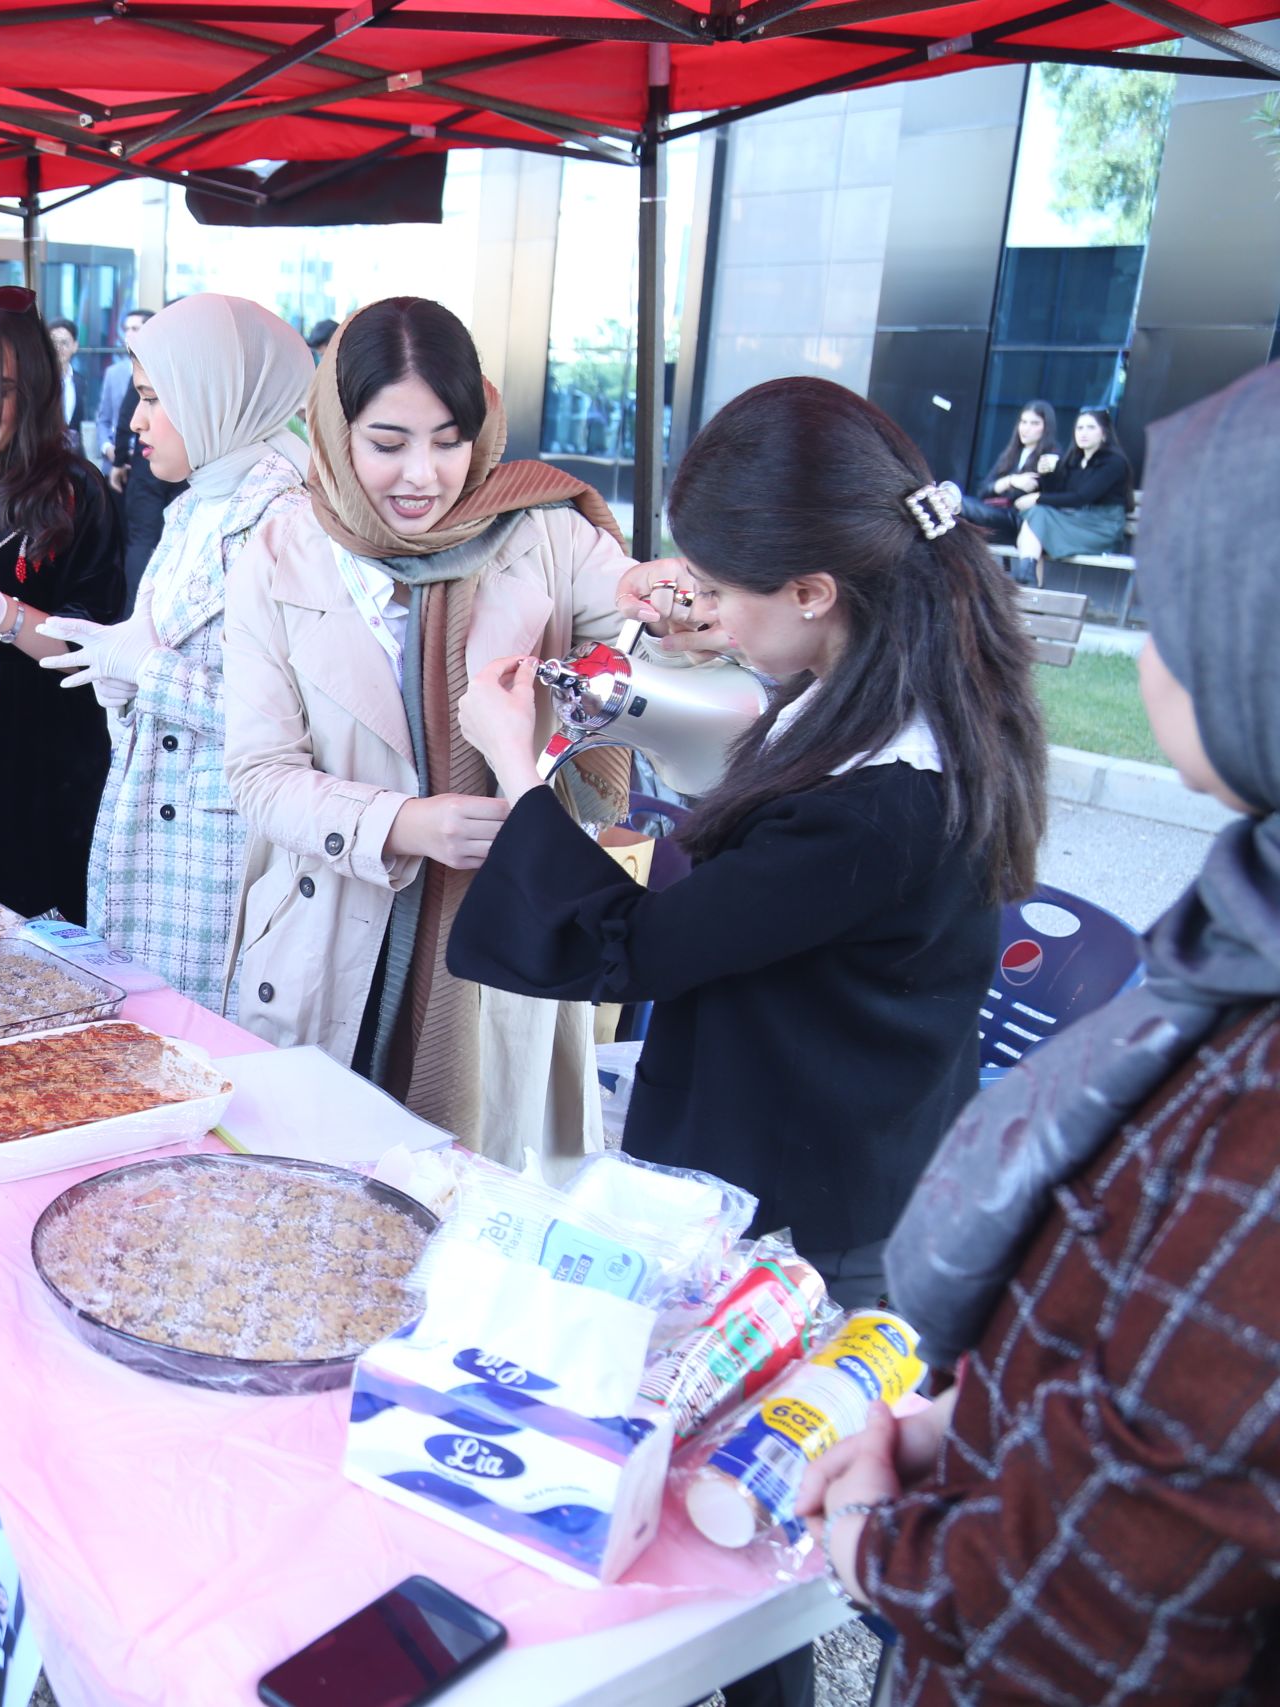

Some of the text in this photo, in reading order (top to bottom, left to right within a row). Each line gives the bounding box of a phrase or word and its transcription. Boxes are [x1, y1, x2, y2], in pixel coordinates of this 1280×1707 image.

[477, 1211, 513, 1246] Teb
[502, 1216, 524, 1258] Plastic
[571, 1259, 591, 1284] CES
[444, 1437, 505, 1477] Lia
